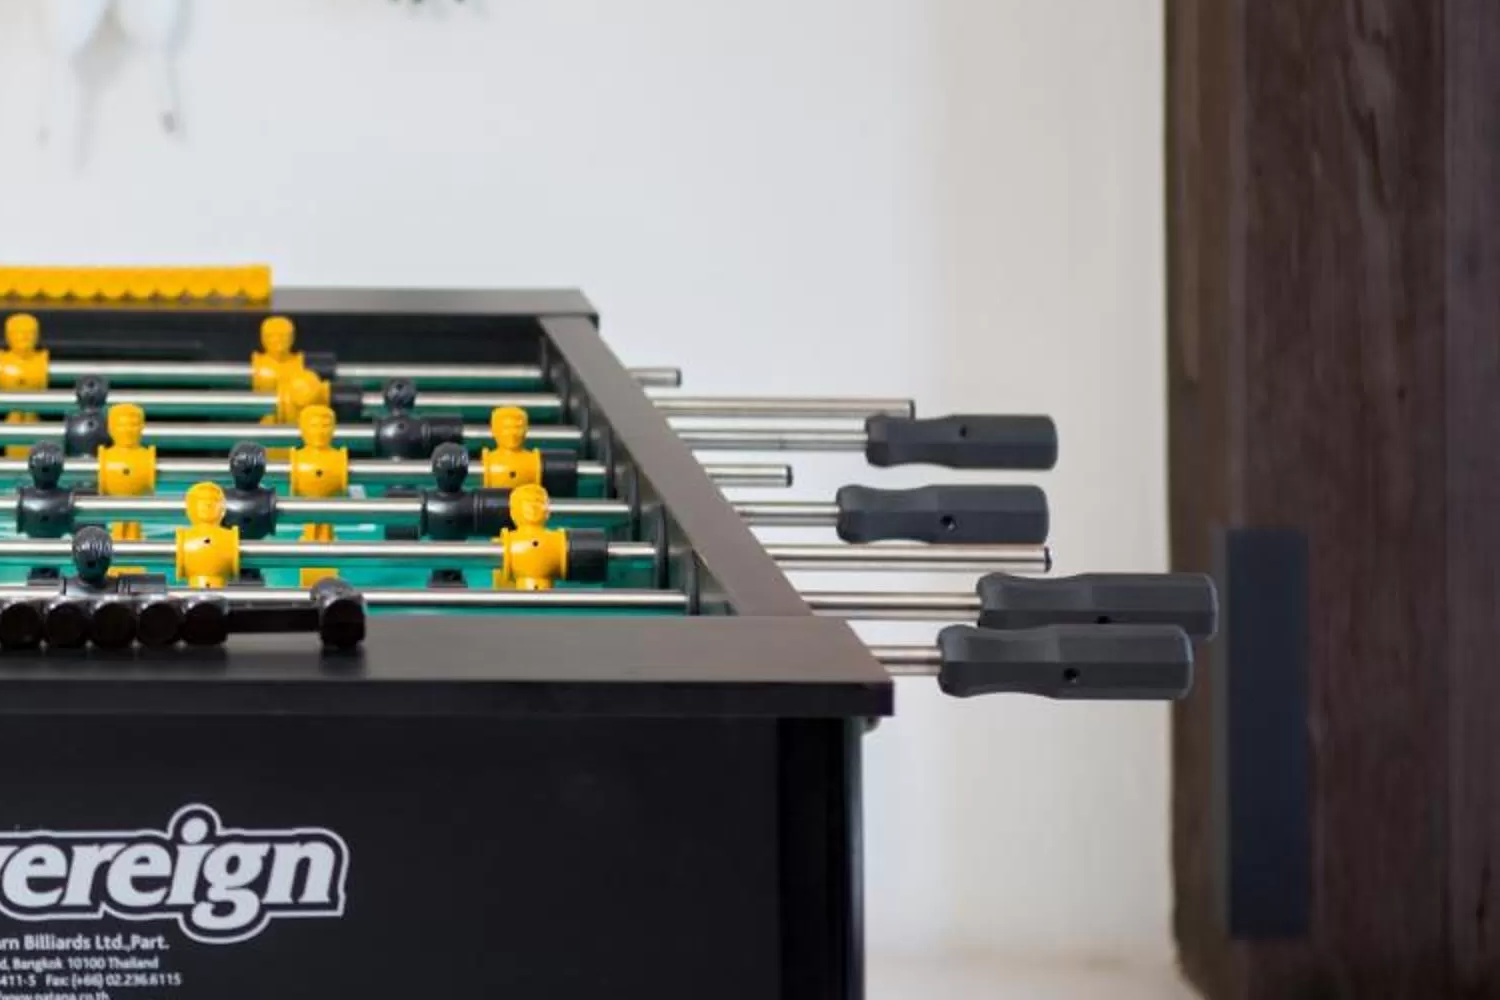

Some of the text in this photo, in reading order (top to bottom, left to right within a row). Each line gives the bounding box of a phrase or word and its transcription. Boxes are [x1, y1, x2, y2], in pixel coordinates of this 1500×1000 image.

[24, 933, 92, 951] Billiards
[12, 957, 62, 973] Bangkok
[67, 957, 106, 970] 10100
[108, 956, 159, 969] Thailand
